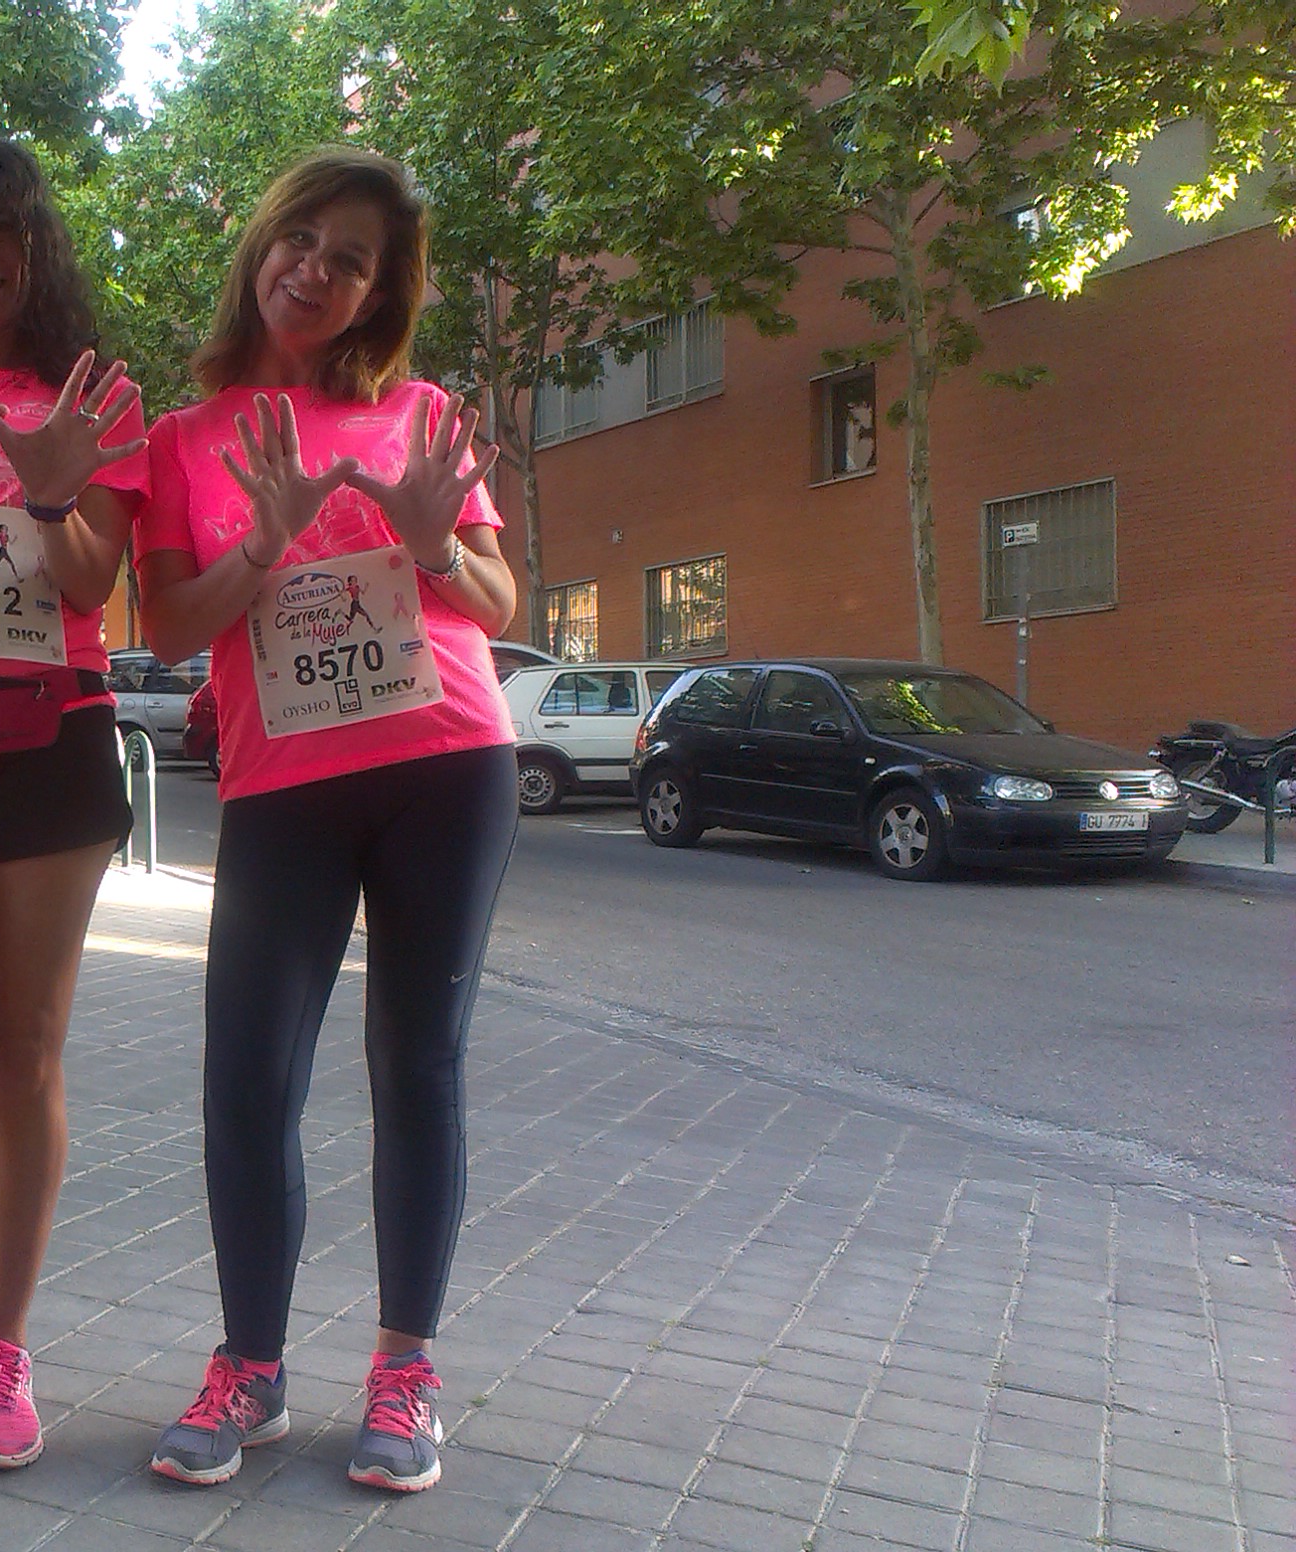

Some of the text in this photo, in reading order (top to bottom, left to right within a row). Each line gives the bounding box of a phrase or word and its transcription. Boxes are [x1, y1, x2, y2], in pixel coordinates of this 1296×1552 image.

[283, 583, 340, 605] ASTURIANA
[275, 607, 331, 630] Carrera
[7, 627, 48, 644] DKV
[290, 616, 354, 648] de la Mujer
[294, 640, 384, 687] 8570
[371, 677, 417, 698] DKV
[282, 699, 331, 719] OYSHO
[342, 700, 358, 710] EVO
[1087, 814, 1103, 829] GU
